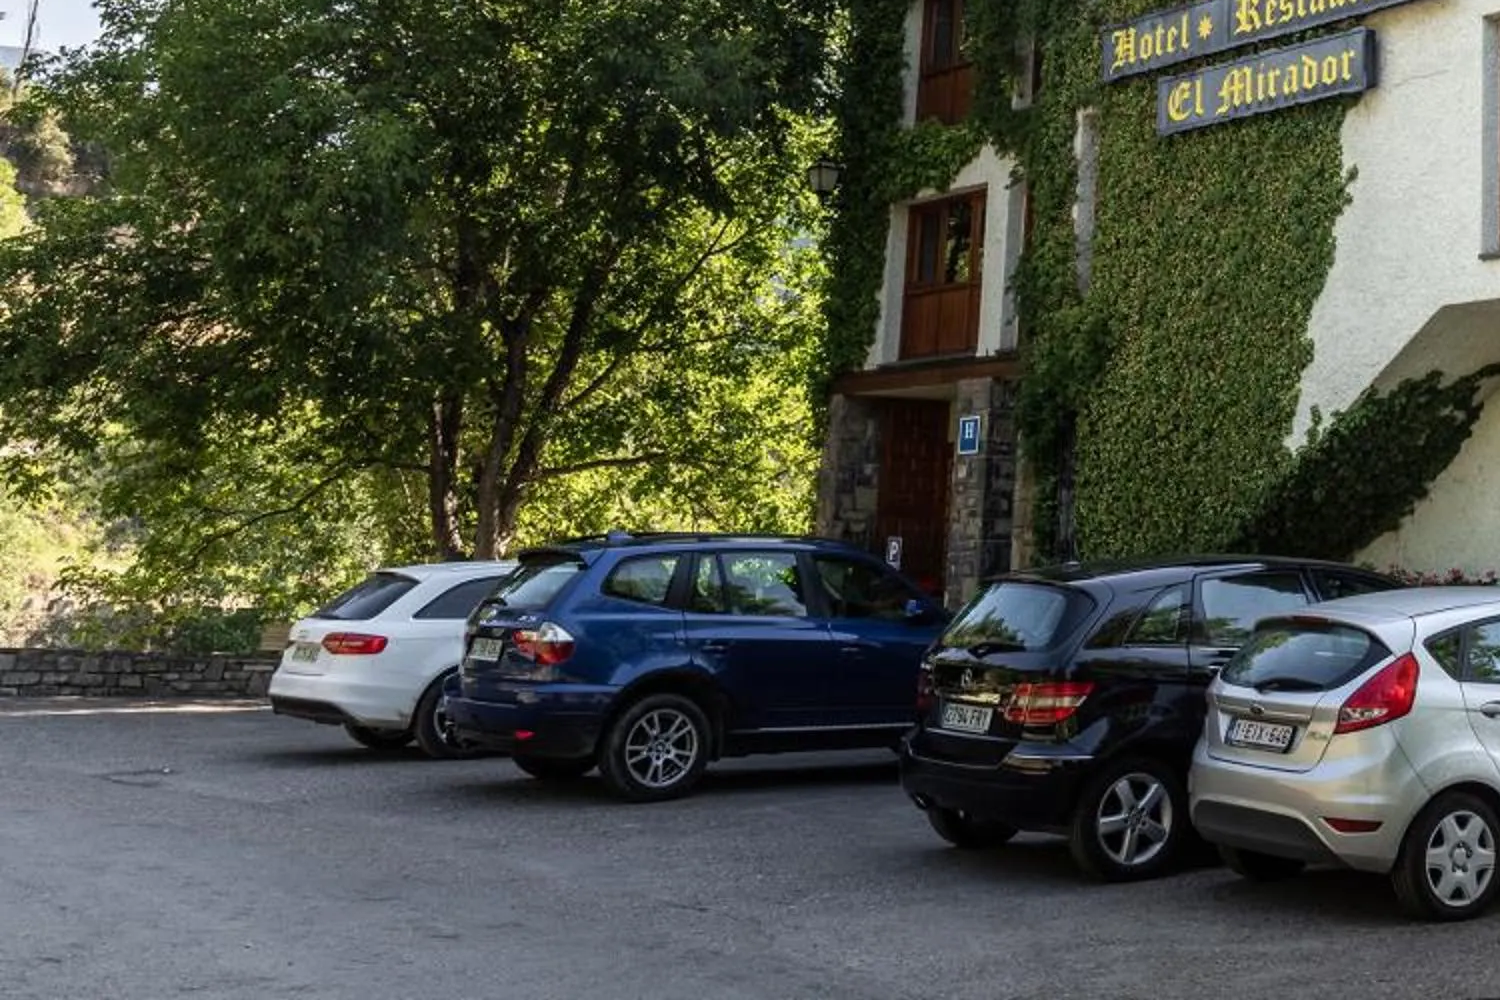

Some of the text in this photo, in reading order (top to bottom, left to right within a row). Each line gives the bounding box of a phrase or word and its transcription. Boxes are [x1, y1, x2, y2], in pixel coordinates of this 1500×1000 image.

[1110, 13, 1190, 75] Hotel
[1167, 48, 1356, 122] El Mirador
[965, 421, 975, 439] H
[889, 541, 899, 561] P
